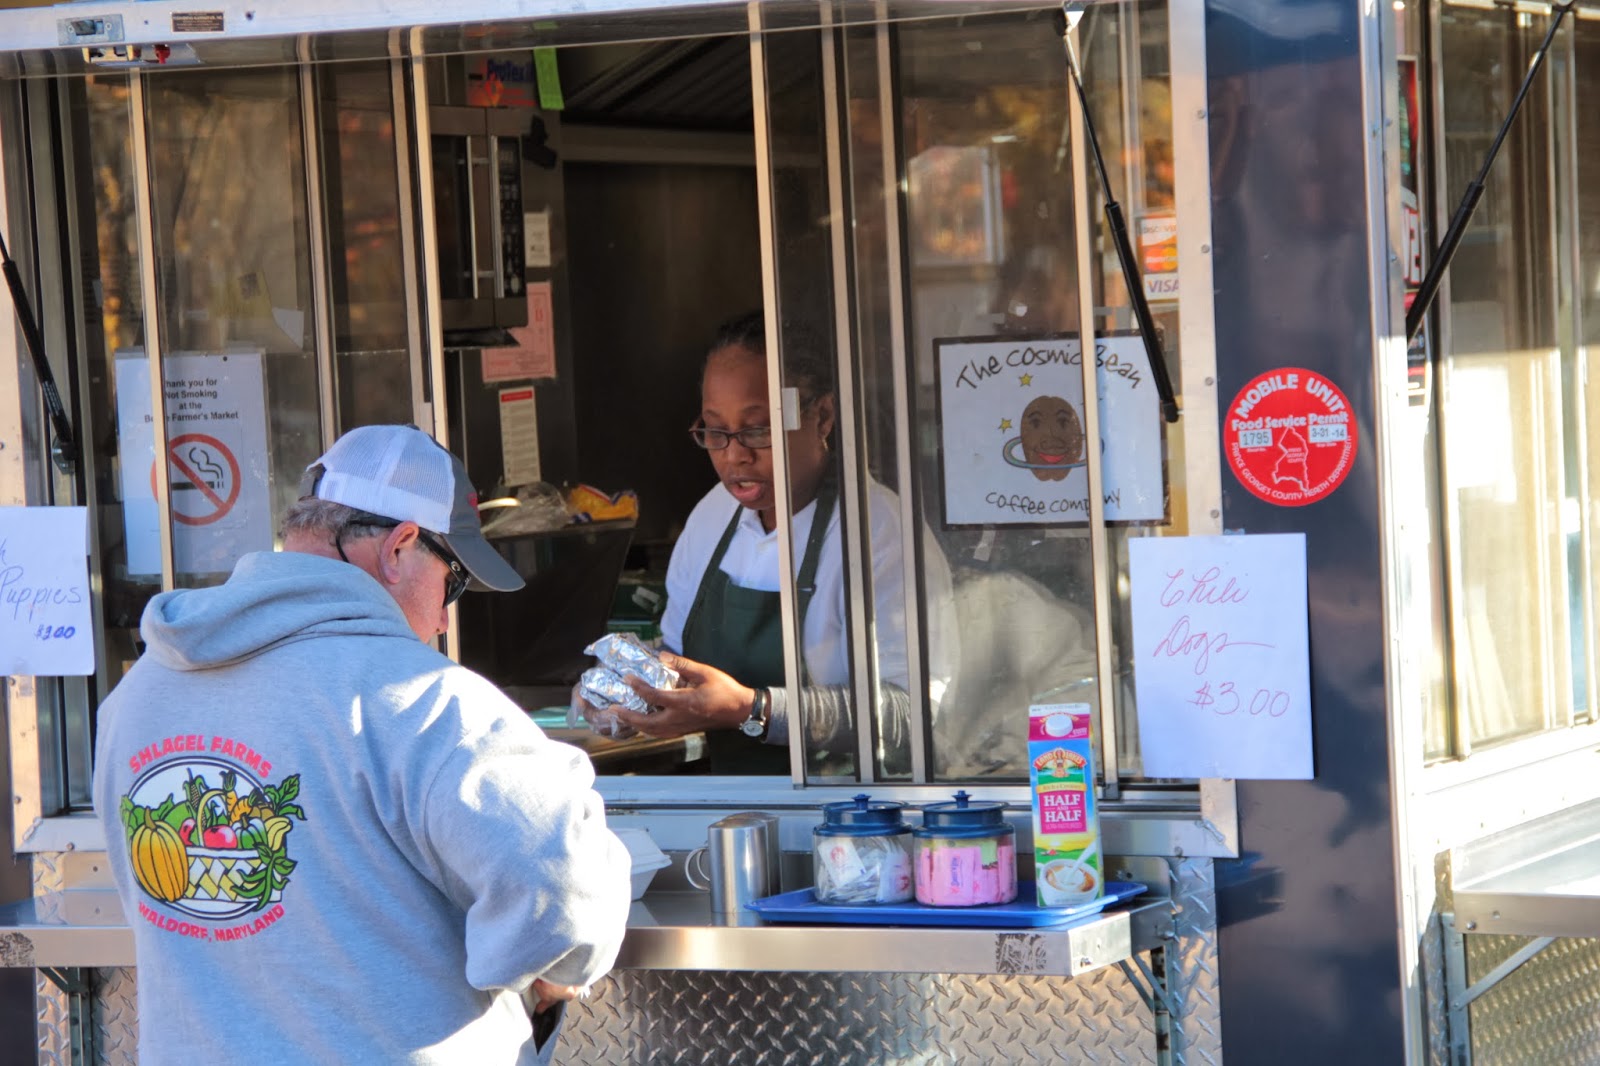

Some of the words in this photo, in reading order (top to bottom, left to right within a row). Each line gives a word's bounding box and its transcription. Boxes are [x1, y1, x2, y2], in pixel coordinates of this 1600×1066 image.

[164, 379, 186, 388] hank
[206, 378, 218, 386] for
[955, 355, 1003, 389] The
[181, 390, 218, 400] Smoking
[1235, 373, 1299, 419] MOBILE
[1305, 377, 1346, 413] UNIT
[172, 413, 208, 422] Farmer's
[210, 411, 239, 420] Market
[1231, 417, 1263, 431] Food
[1265, 414, 1307, 429] Service
[1308, 411, 1349, 425] Permit
[1242, 431, 1270, 446] 1795
[1231, 442, 1246, 469] PRINCE
[1271, 489, 1303, 500] COUNTY
[1304, 481, 1330, 498] HEALTH
[1328, 435, 1352, 483] DEPARTMENT
[0, 565, 81, 624] Puppies
[1153, 615, 1276, 676] Dogs
[1186, 681, 1290, 718] $3.00
[128, 734, 206, 775] SHLAGEL
[210, 735, 273, 779] FARMS
[1043, 794, 1081, 807] HALF
[1045, 810, 1082, 823] HALF
[137, 900, 213, 943] WALDORF,
[214, 903, 285, 942] MARYLAND
